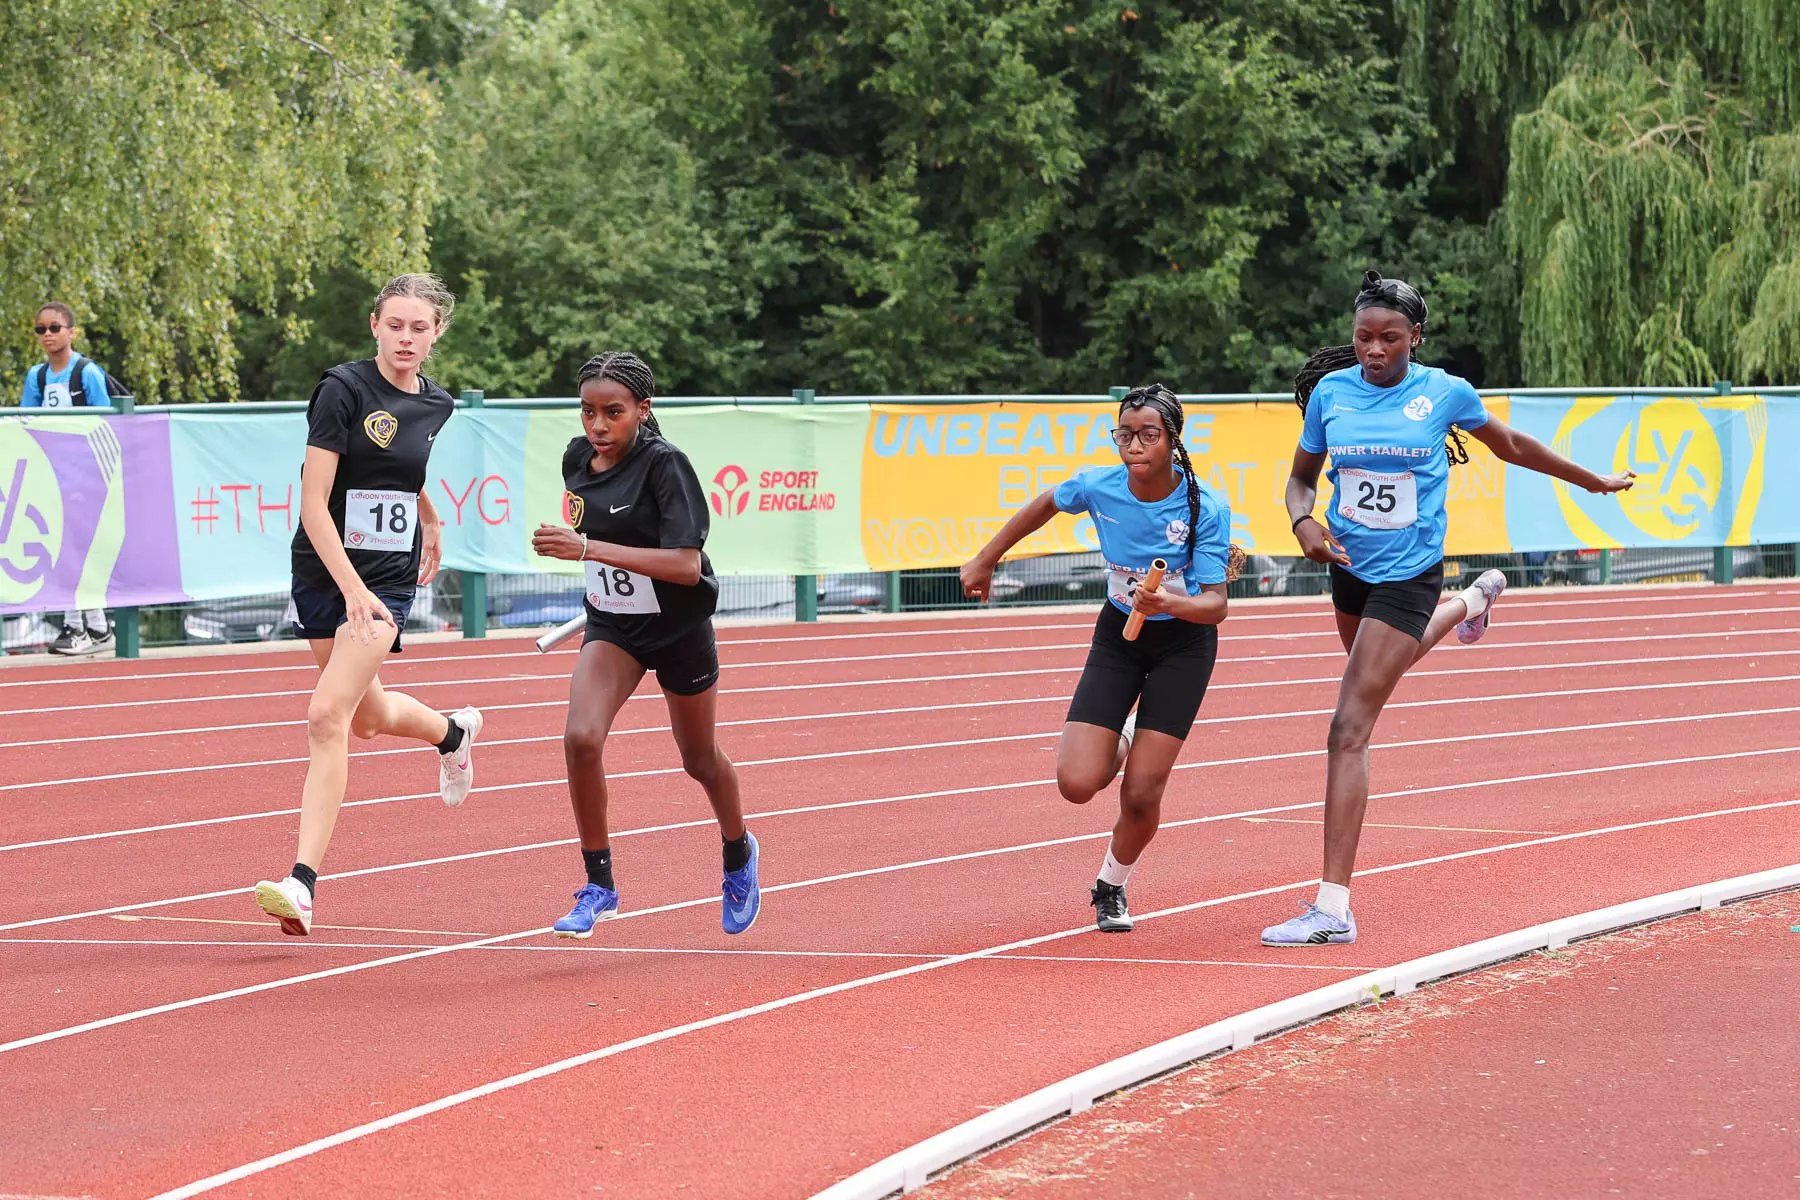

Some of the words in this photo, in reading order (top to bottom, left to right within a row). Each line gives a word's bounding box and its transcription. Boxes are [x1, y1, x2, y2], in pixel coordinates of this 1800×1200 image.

[873, 411, 1216, 458] UNBEATAE
[1370, 446, 1432, 458] HAMLETS
[760, 470, 818, 489] SPORT
[758, 492, 836, 512] ENGLAND
[1357, 480, 1397, 513] 25
[369, 502, 408, 534] 18
[597, 566, 636, 597] 18
